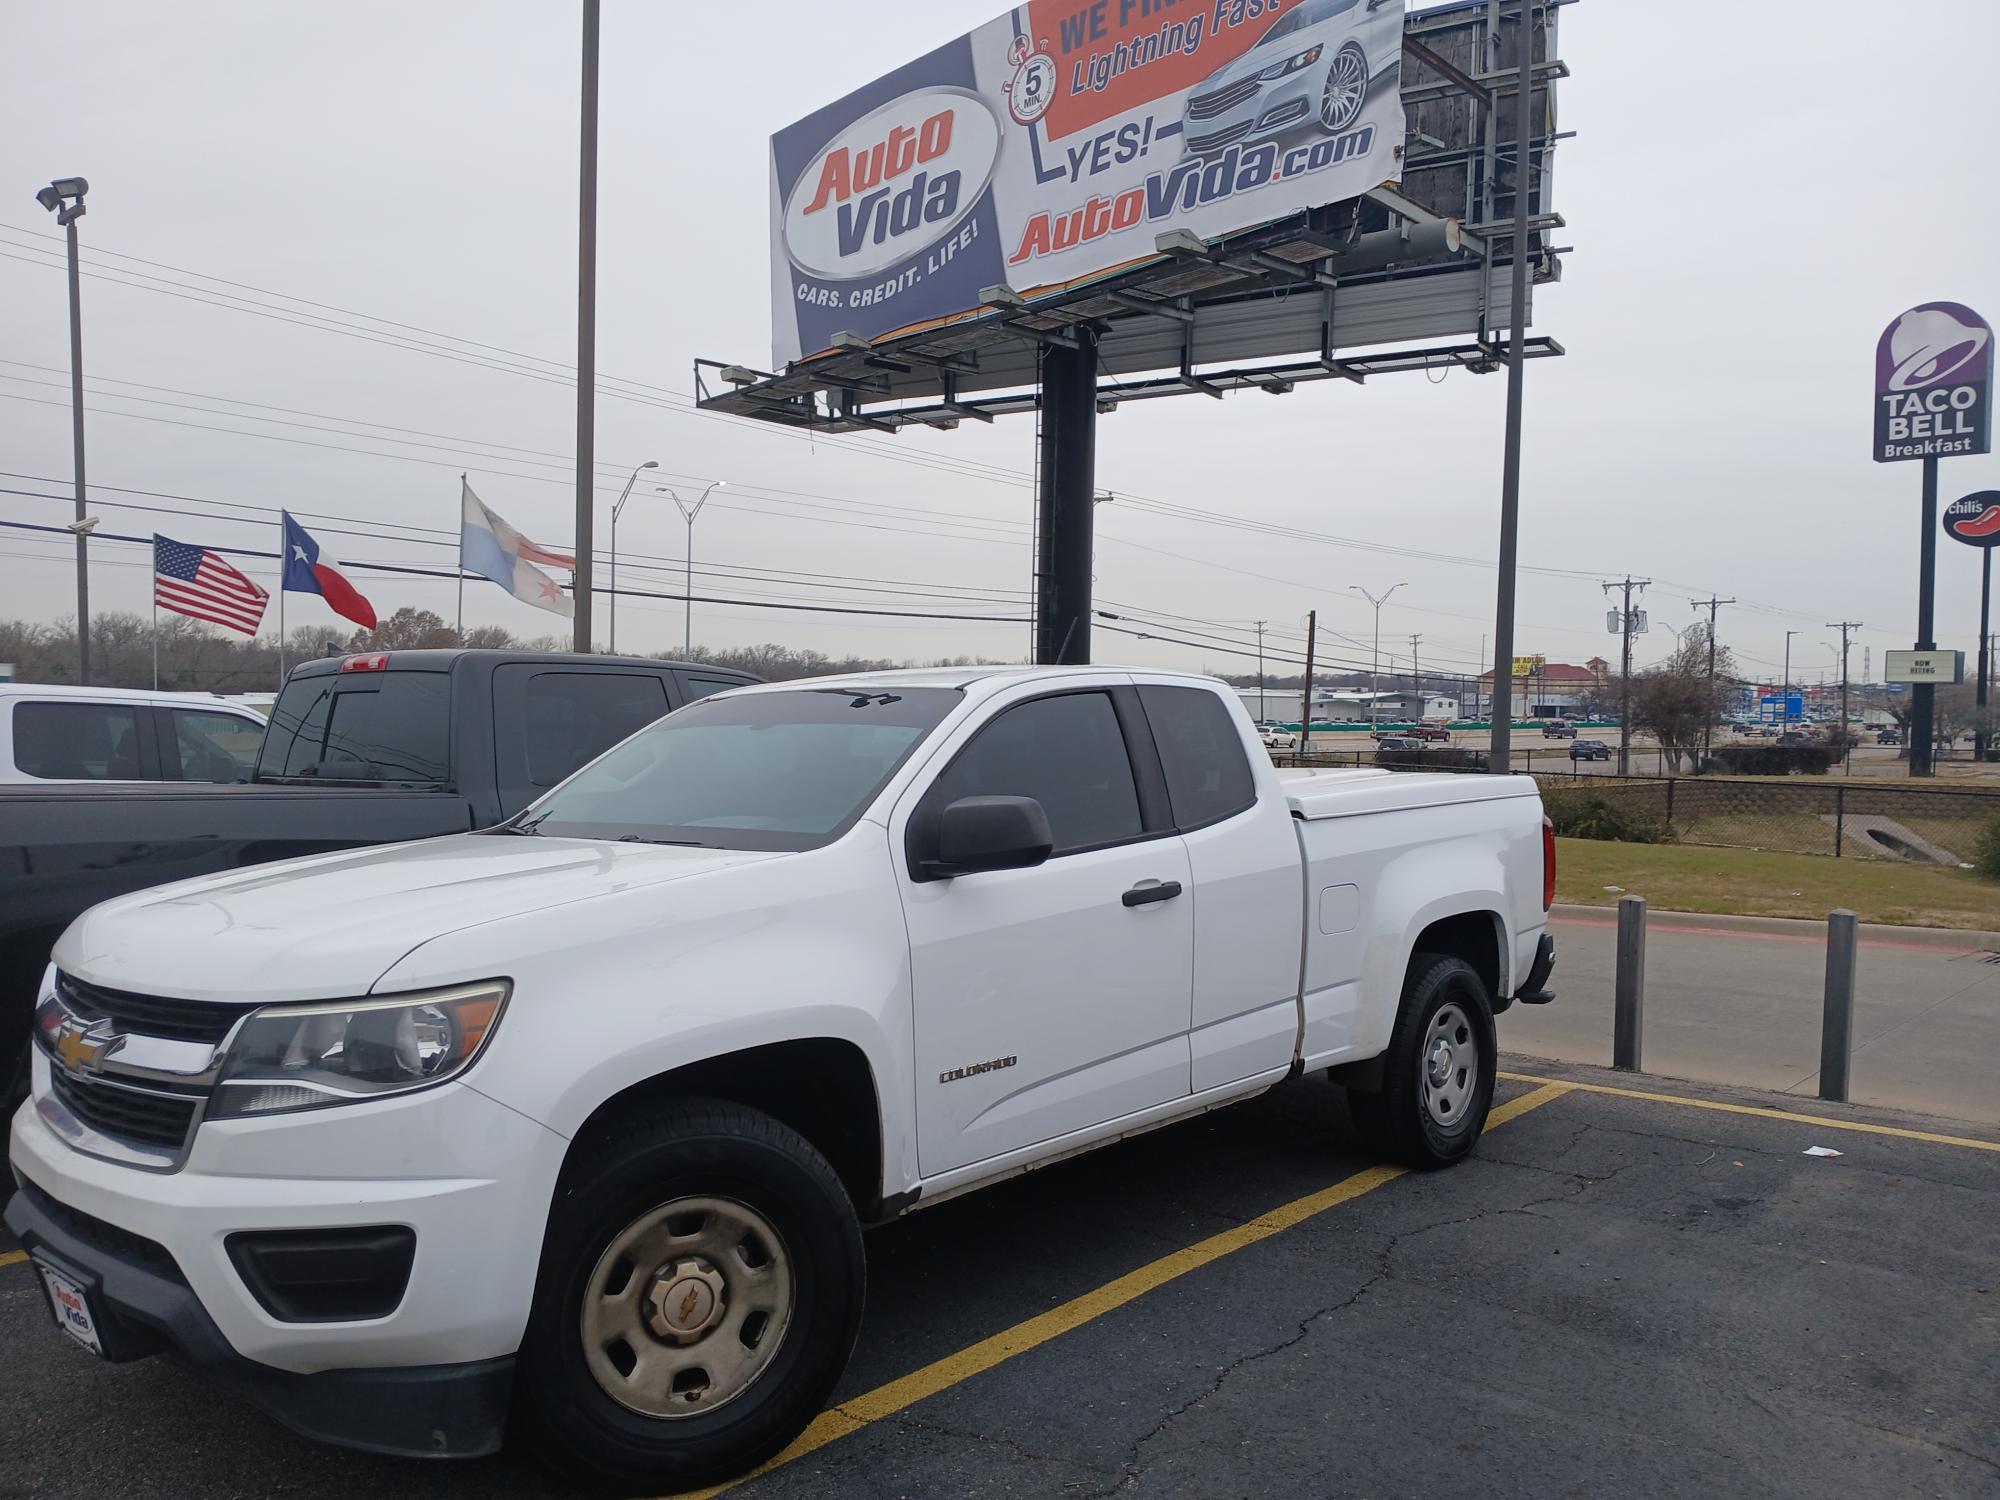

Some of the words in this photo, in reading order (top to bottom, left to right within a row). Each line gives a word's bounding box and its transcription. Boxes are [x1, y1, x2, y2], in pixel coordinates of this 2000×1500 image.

[1060, 1, 1107, 55] WE
[1071, 13, 1206, 96] Lightning
[1025, 65, 1042, 96] 5
[803, 109, 954, 216] Auto
[1065, 116, 1154, 182] YES!
[837, 170, 961, 257] Vida
[1009, 126, 1374, 265] AutoVida.com
[797, 283, 843, 308] CARS.
[850, 266, 921, 308] CREDIT.
[928, 218, 979, 275] LIFE!
[1883, 386, 1977, 417] TACO
[1889, 411, 1975, 440] BELL
[1884, 438, 1972, 458] Breakfast
[940, 1054, 1018, 1084] COLORADO
[56, 1285, 82, 1312] Auto
[64, 1304, 89, 1330] Vida
